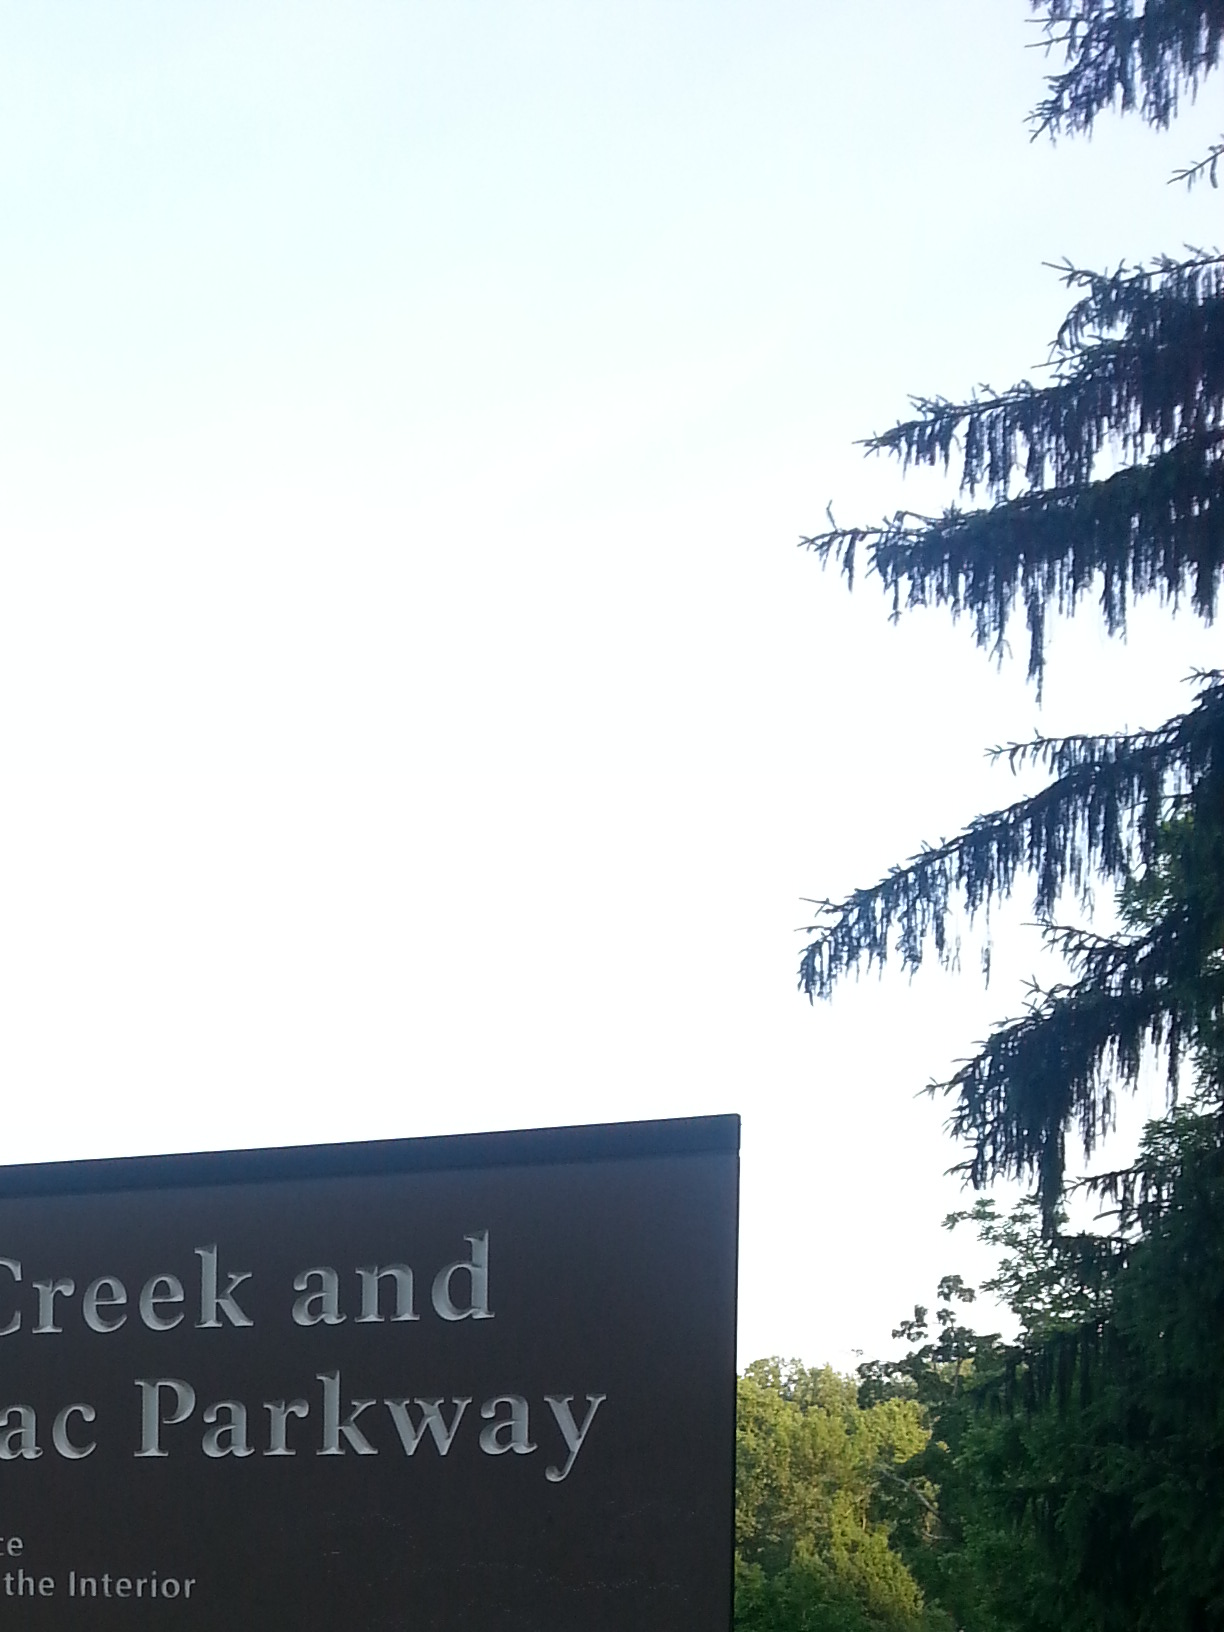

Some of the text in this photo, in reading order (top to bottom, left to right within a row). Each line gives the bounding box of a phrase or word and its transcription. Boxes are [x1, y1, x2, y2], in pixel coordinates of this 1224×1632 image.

[291, 1230, 496, 1326] and
[132, 1370, 608, 1483] Parkway
[3, 1568, 56, 1597] the
[68, 1570, 197, 1599] Interior
